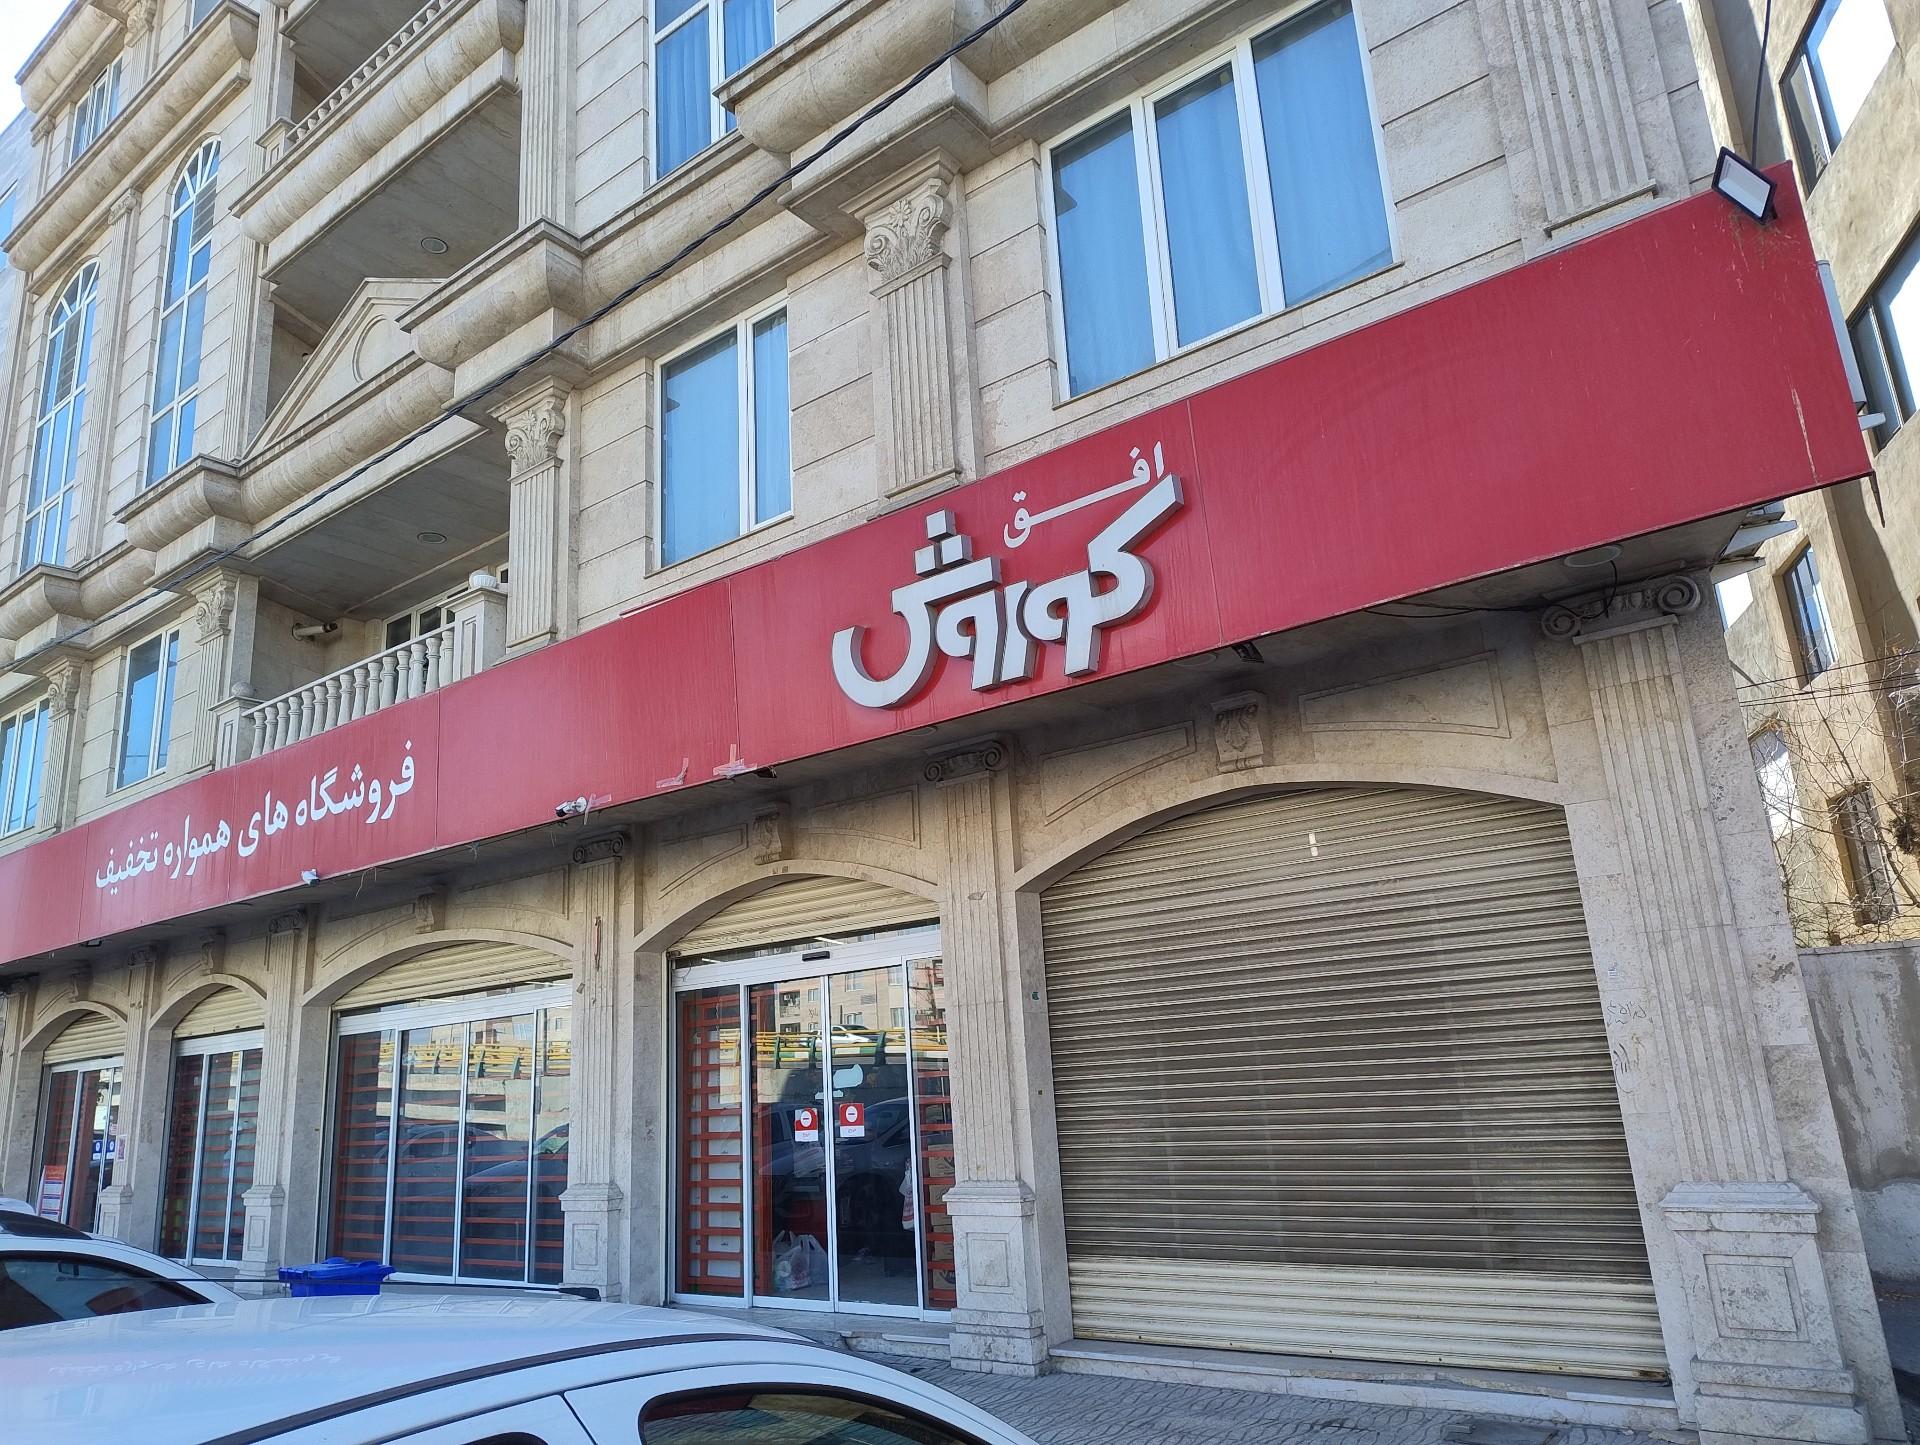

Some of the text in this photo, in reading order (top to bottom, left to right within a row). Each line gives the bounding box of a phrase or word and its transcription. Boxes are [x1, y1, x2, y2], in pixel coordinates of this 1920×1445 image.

[1003, 441, 1165, 548] افق
[832, 474, 1184, 708] کوروش
[95, 739, 416, 896] فروشگاه های همواره تخفیف
